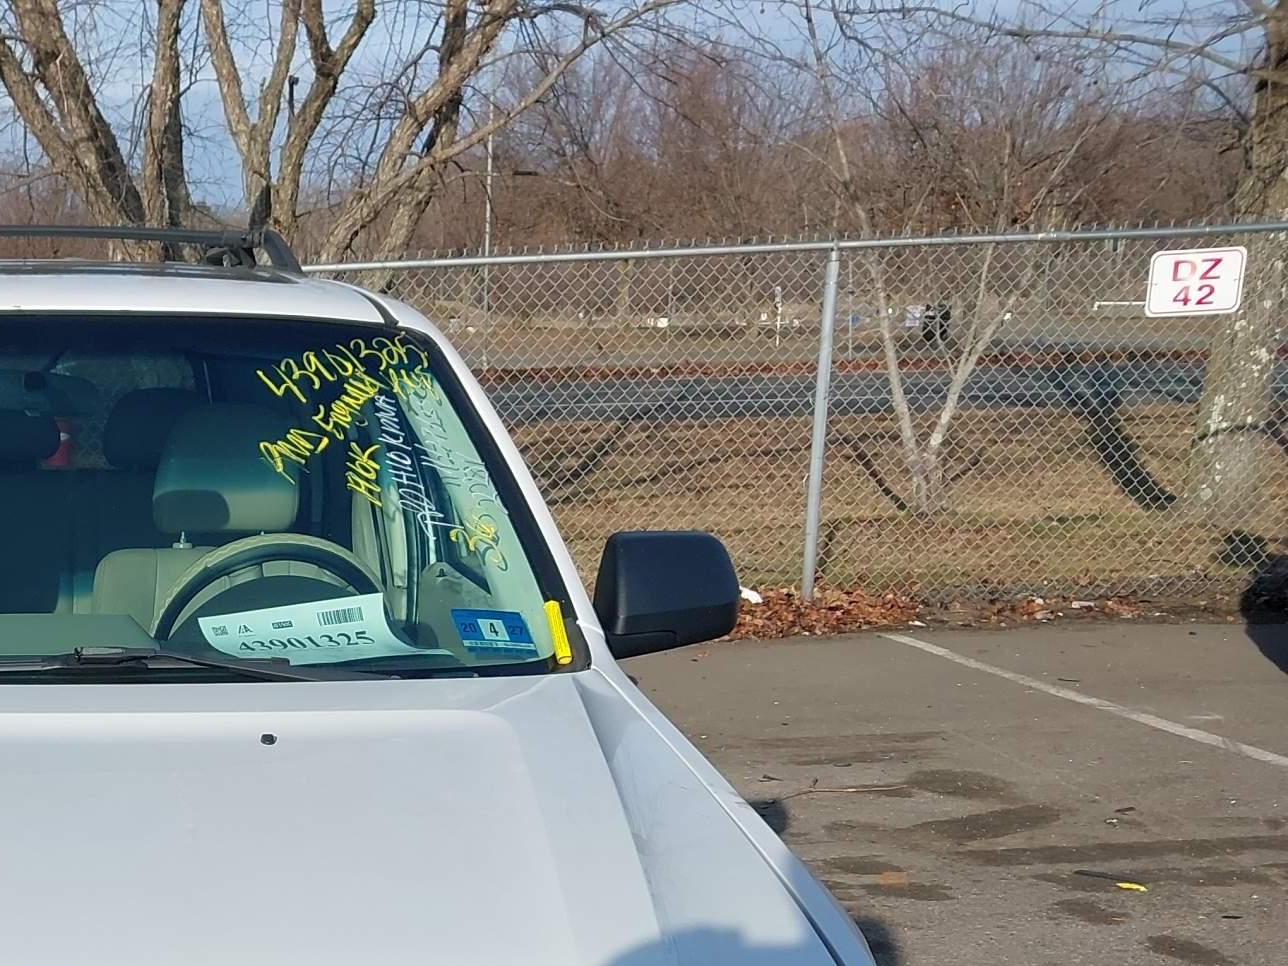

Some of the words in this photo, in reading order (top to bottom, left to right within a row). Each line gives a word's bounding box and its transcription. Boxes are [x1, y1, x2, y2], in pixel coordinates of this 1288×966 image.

[1172, 257, 1224, 282] DZ
[1173, 284, 1215, 306] 42
[489, 622, 499, 636] 4
[239, 631, 375, 651] 43901325
